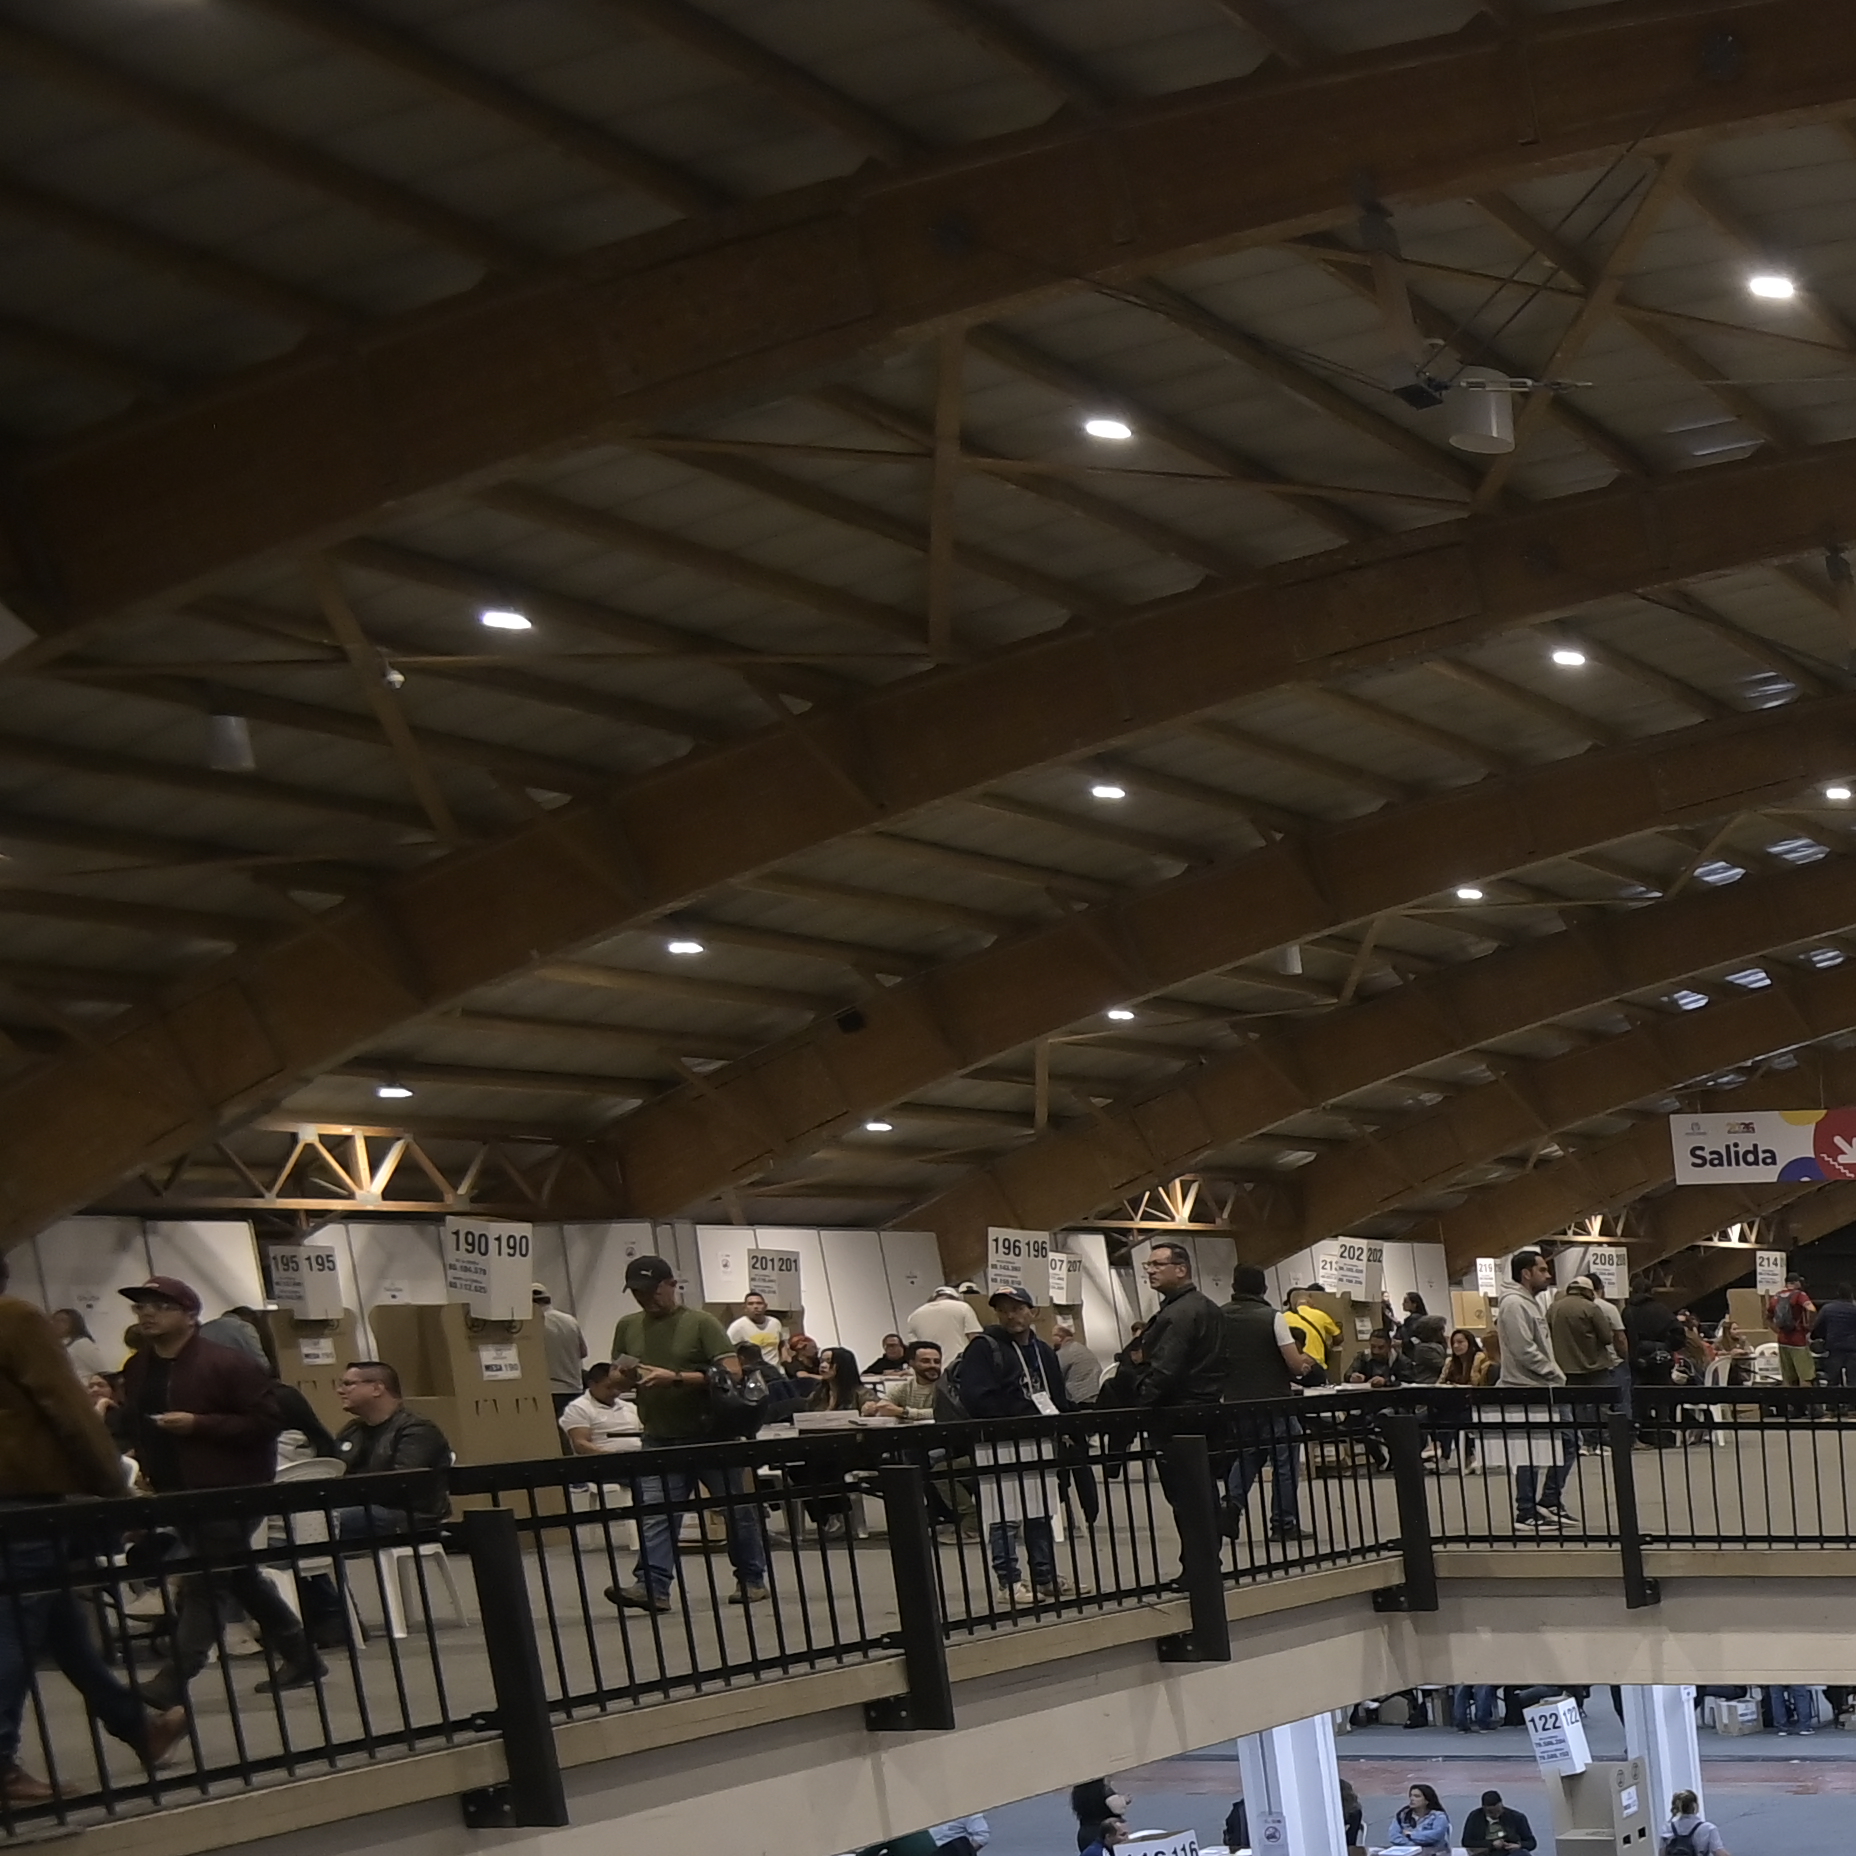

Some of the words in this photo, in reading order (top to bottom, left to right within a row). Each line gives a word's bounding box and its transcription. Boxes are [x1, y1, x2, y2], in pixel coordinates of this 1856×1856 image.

[1690, 1142, 1778, 1170] Salida
[452, 1229, 489, 1257] 190
[494, 1234, 530, 1257] 190
[992, 1236, 1021, 1257] 196
[1025, 1240, 1048, 1258] 196
[1340, 1244, 1364, 1262] 202
[1367, 1248, 1383, 1264] 202
[1592, 1252, 1615, 1267] 208
[1758, 1255, 1779, 1269] 214
[273, 1254, 300, 1273] 195
[305, 1253, 336, 1273] 195
[751, 1254, 775, 1271] 201
[778, 1256, 797, 1272] 201
[1049, 1257, 1065, 1272] 07
[1529, 1712, 1561, 1734] 122
[1562, 1707, 1579, 1728] 122
